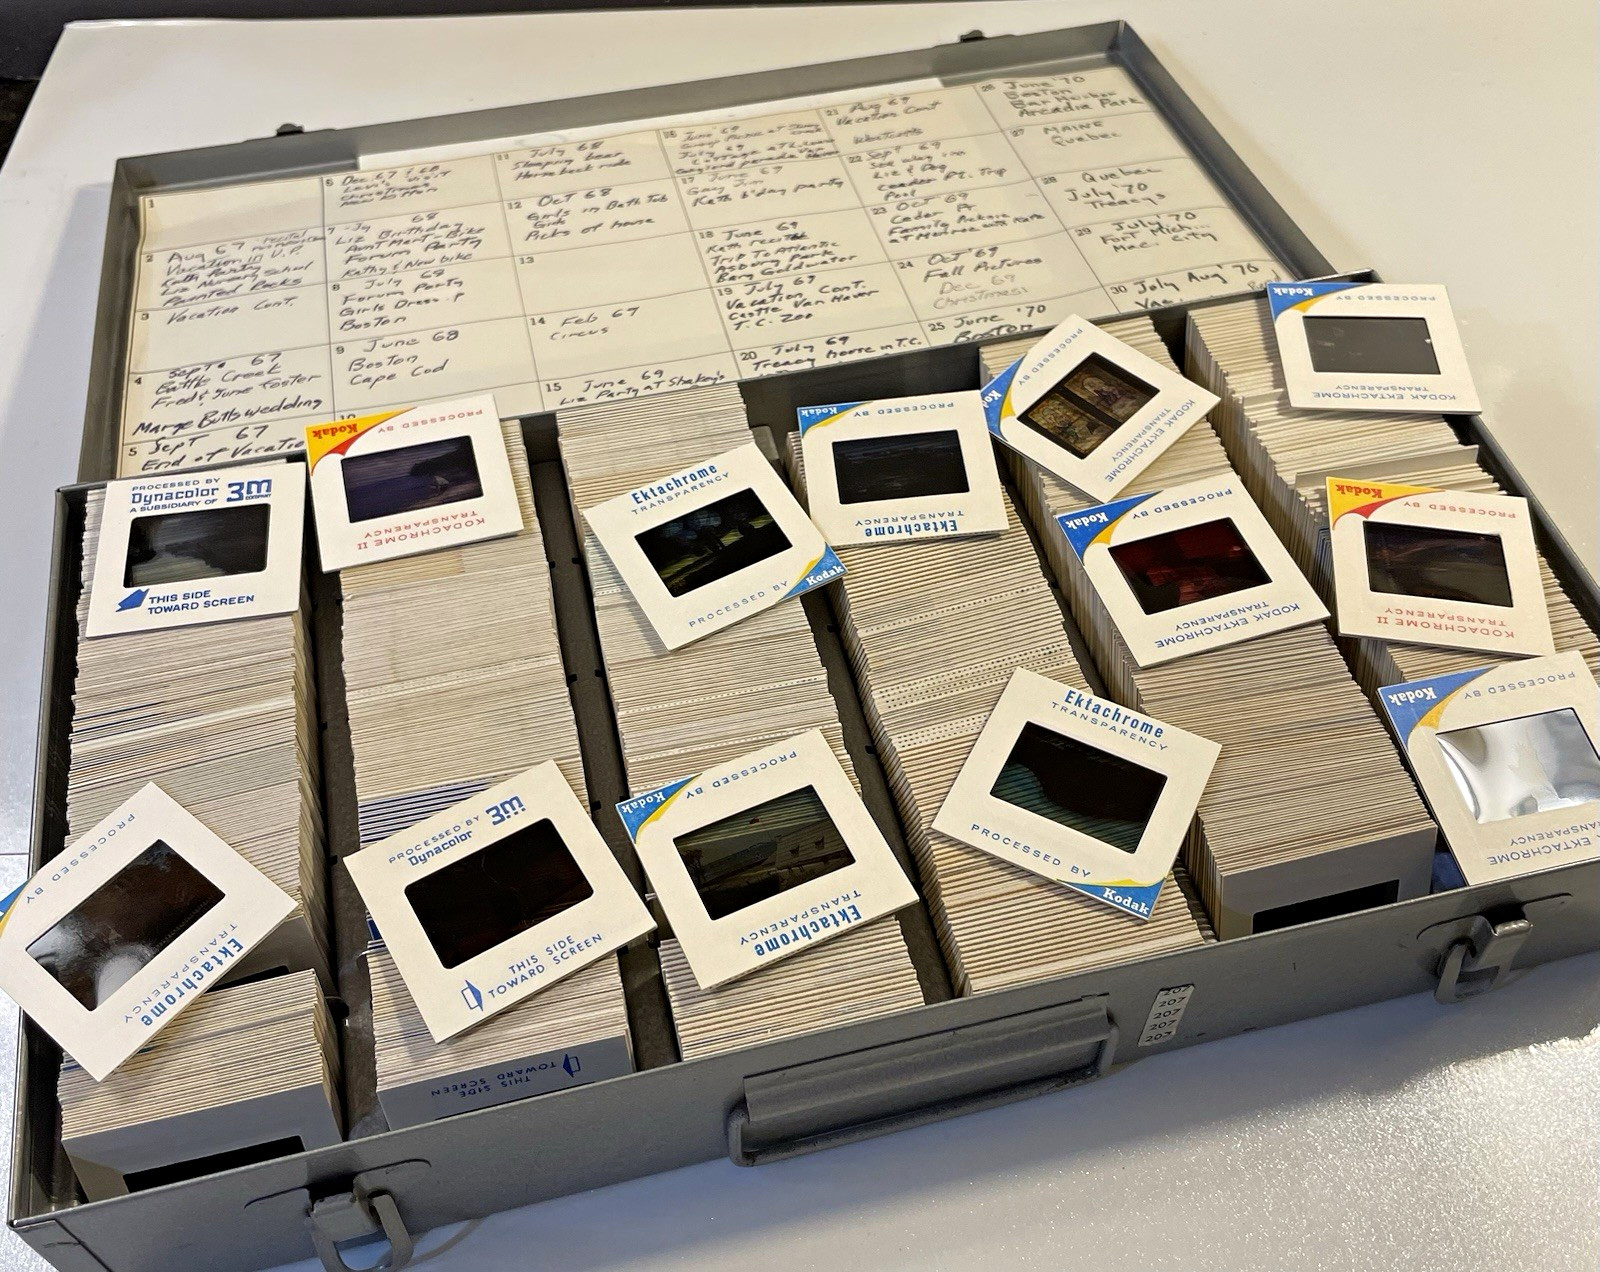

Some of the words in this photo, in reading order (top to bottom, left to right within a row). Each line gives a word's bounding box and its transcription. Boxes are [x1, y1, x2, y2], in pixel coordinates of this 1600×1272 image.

[718, 288, 732, 296] 19
[1111, 286, 1127, 294] 30
[1274, 287, 1313, 296] Kodak
[337, 346, 344, 354] 9
[741, 352, 757, 361] 20
[1032, 329, 1082, 373] PROCESSED
[411, 359, 449, 377] Cod
[134, 377, 142, 385] 4
[546, 383, 561, 392] 15
[1018, 375, 1030, 385] BY
[983, 390, 1001, 409] Kod
[1313, 392, 1404, 400] EKTACHROME
[802, 408, 837, 416] Kodak
[878, 403, 954, 414] PROCESSED
[1167, 400, 1194, 427] KODAK
[403, 410, 482, 428] PROCESSED
[236, 425, 268, 439] 67
[313, 424, 357, 438] Kodak
[1112, 409, 1171, 462] TRANSPARENCY
[1105, 428, 1165, 482] EKTACHROME
[132, 480, 199, 491] PROCESSED
[631, 465, 717, 504] Ektachrome
[631, 472, 729, 515] TRANSPARENCY
[1336, 484, 1382, 498] Kodak
[132, 487, 219, 505] Dynacolor
[1155, 489, 1232, 513] PROCESSED
[140, 501, 200, 512] SUBSIDIARY
[1133, 511, 1148, 519] BY
[1429, 504, 1516, 518] PROCESSED
[365, 511, 477, 538] TRANSPARENCY
[856, 511, 964, 526] TRANSPARENCY
[1066, 512, 1108, 529] Kodak
[375, 518, 485, 546] KODACHROME
[865, 520, 957, 537] Ektachrome
[806, 565, 845, 586] Kodak
[148, 602, 199, 614] TOWARD
[204, 595, 254, 607] SCREEN
[149, 595, 178, 604] THIS
[183, 590, 211, 599] SIDE
[689, 591, 765, 628] PROCESSED
[773, 581, 788, 590] BY
[1176, 602, 1269, 631] TRANSPARENCY
[1253, 603, 1300, 620] KODAK
[1385, 608, 1507, 626] TRANSPARENCY
[1155, 619, 1248, 648] EKTACHROME
[1395, 619, 1514, 638] KODACHROME
[1489, 671, 1575, 694] PROCESSED
[1388, 688, 1437, 706] Kodak
[1465, 690, 1481, 699] BY
[1065, 690, 1163, 738] Ektachrome
[1052, 703, 1168, 750] TRANSPARENCY
[712, 751, 796, 788] PROCESSED
[686, 788, 703, 799] BY
[621, 792, 665, 814] Kodak
[52, 814, 134, 881] PROCESSED
[389, 826, 461, 863] PROCESSED
[466, 816, 479, 826] BY
[408, 830, 472, 866] Dynacolor
[971, 824, 1060, 866] PROCESSED
[1071, 866, 1091, 878] BY
[1488, 837, 1591, 865] EKTACHROME
[26, 888, 43, 903] BY
[1103, 888, 1149, 914] Kodak
[740, 890, 861, 945] TRANSPARENCY
[755, 905, 861, 956] Ektachrome
[509, 955, 538, 974] THIS
[546, 935, 574, 956] SIDE
[125, 924, 237, 1023] TRANSPARENCY
[488, 964, 545, 998] TOWARD
[552, 934, 602, 964] SCREEN
[141, 939, 243, 1025] Ektachrome
[1159, 997, 1186, 1007] 207
[1154, 1009, 1180, 1019] 207
[1149, 1020, 1177, 1030] 207
[1145, 1031, 1172, 1042] 207
[497, 1062, 556, 1079] TOWARD
[431, 1078, 485, 1096] SCREEN
[501, 1076, 530, 1087] THIS
[460, 1086, 490, 1097] SIDE
